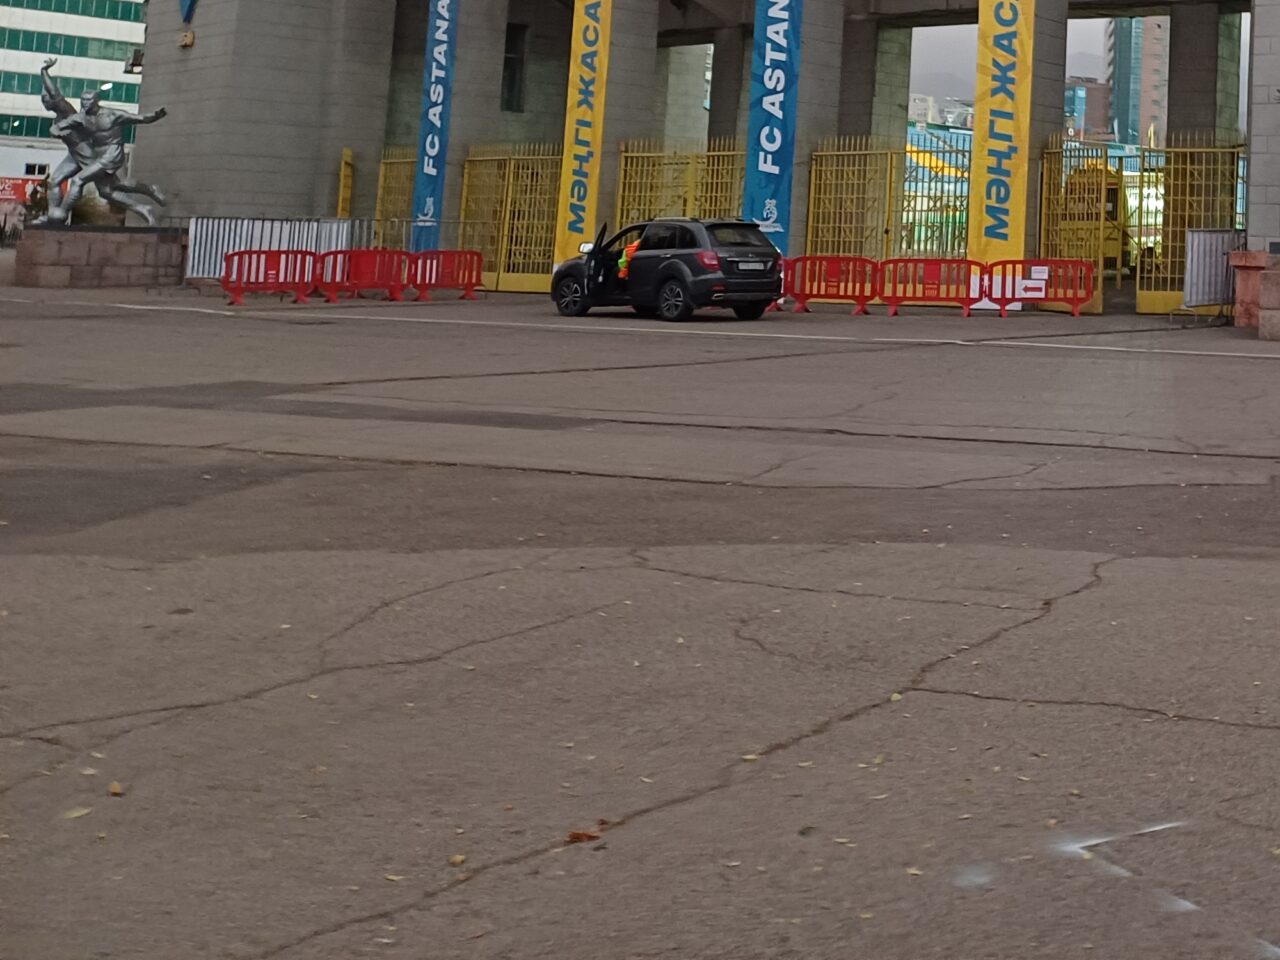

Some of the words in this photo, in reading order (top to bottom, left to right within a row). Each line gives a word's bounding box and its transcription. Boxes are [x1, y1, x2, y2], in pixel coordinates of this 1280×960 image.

[423, 133, 440, 176] FC
[567, 118, 594, 234] МӘҢГІ
[758, 126, 783, 174] FC
[984, 108, 1018, 242] МӘҢГІ
